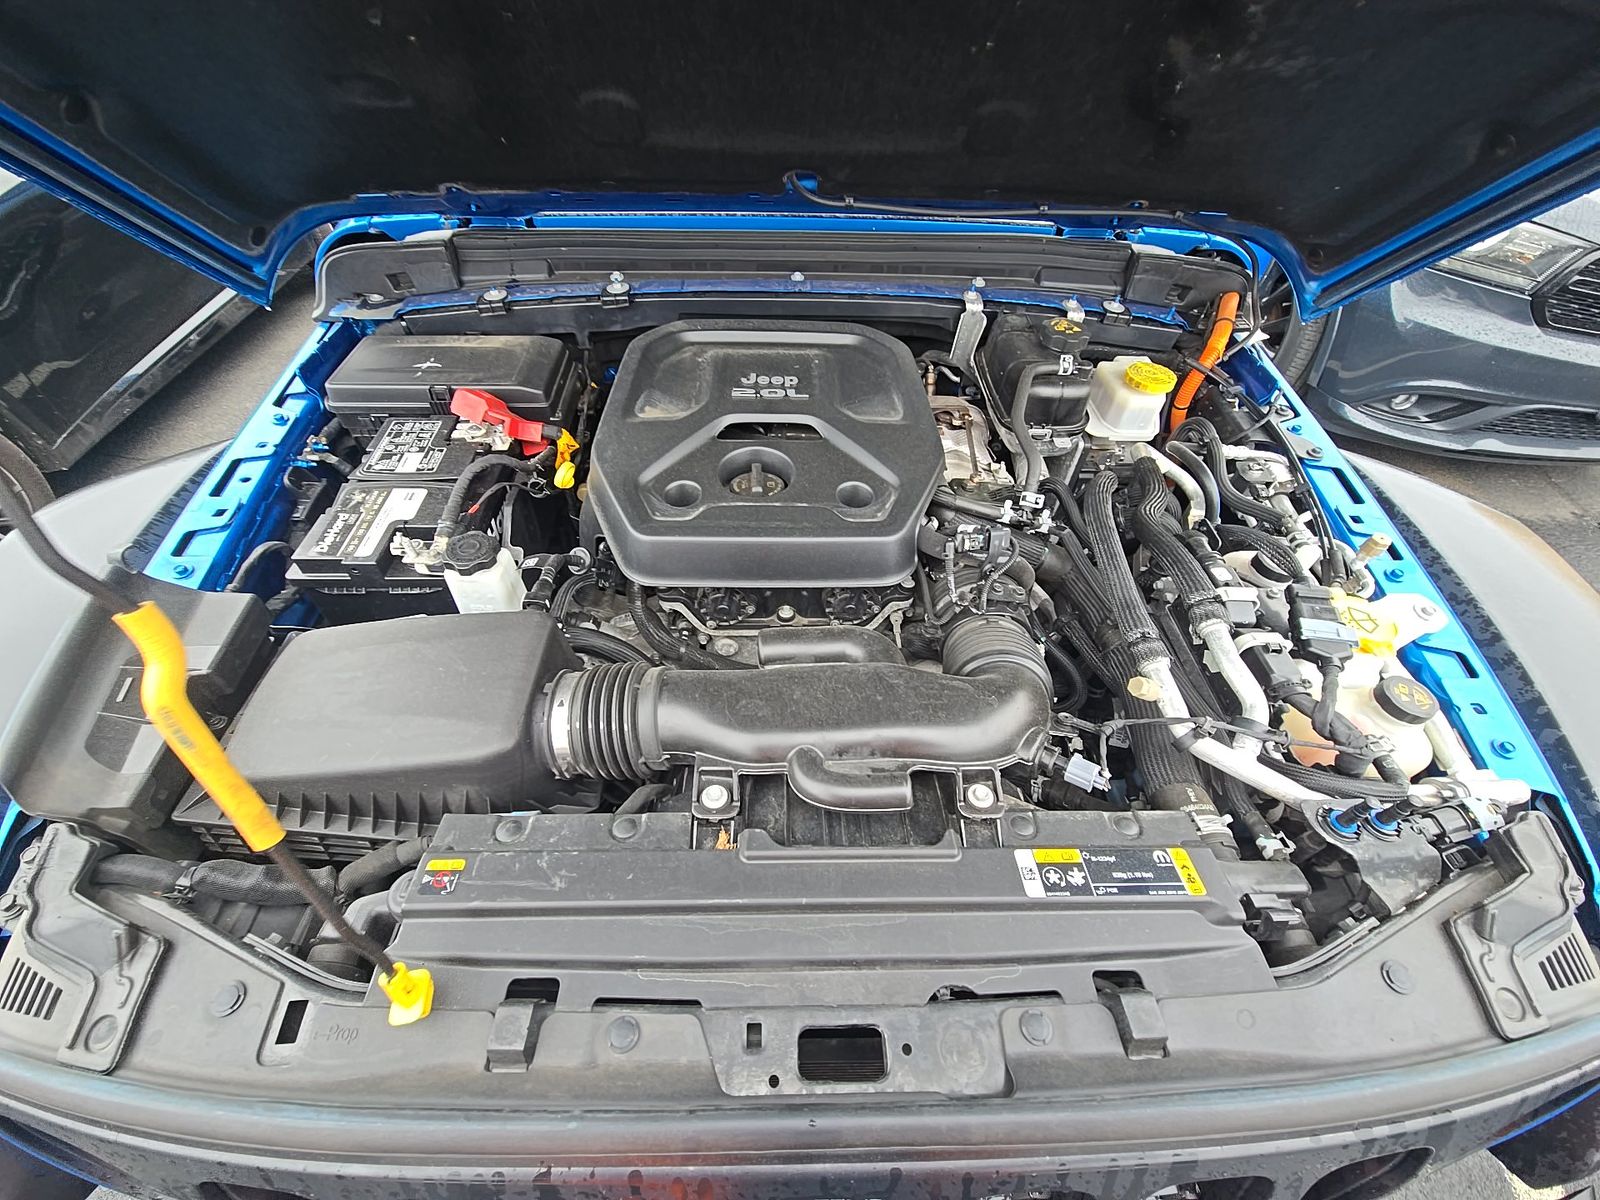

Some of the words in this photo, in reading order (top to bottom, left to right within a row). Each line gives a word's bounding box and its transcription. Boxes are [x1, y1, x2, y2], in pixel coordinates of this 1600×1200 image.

[740, 372, 799, 387] Jeep
[731, 387, 810, 399] 2.0L
[313, 512, 350, 553] DieHard
[326, 1024, 359, 1045] Prop
